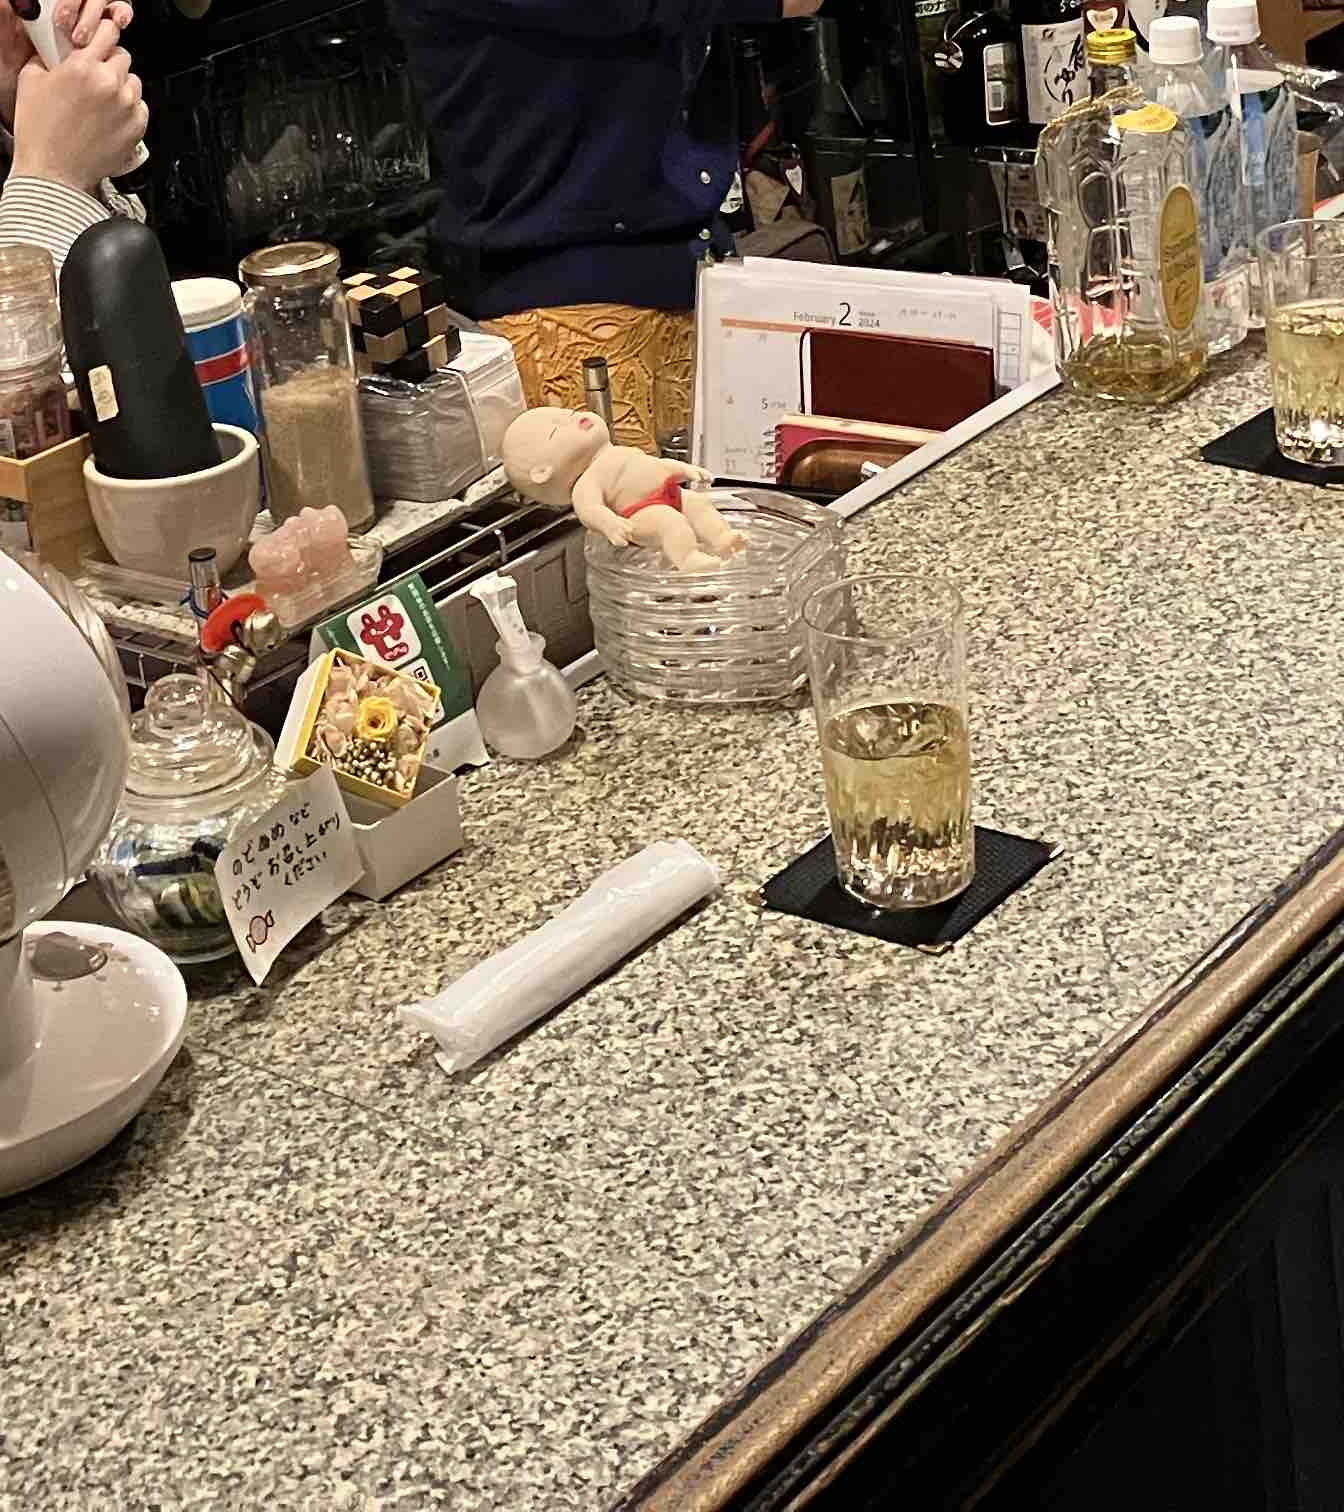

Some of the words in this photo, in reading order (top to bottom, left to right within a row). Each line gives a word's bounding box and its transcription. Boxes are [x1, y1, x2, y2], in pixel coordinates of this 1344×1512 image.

[793, 310, 837, 328] February
[838, 301, 852, 326] 2
[858, 318, 880, 329] 2024
